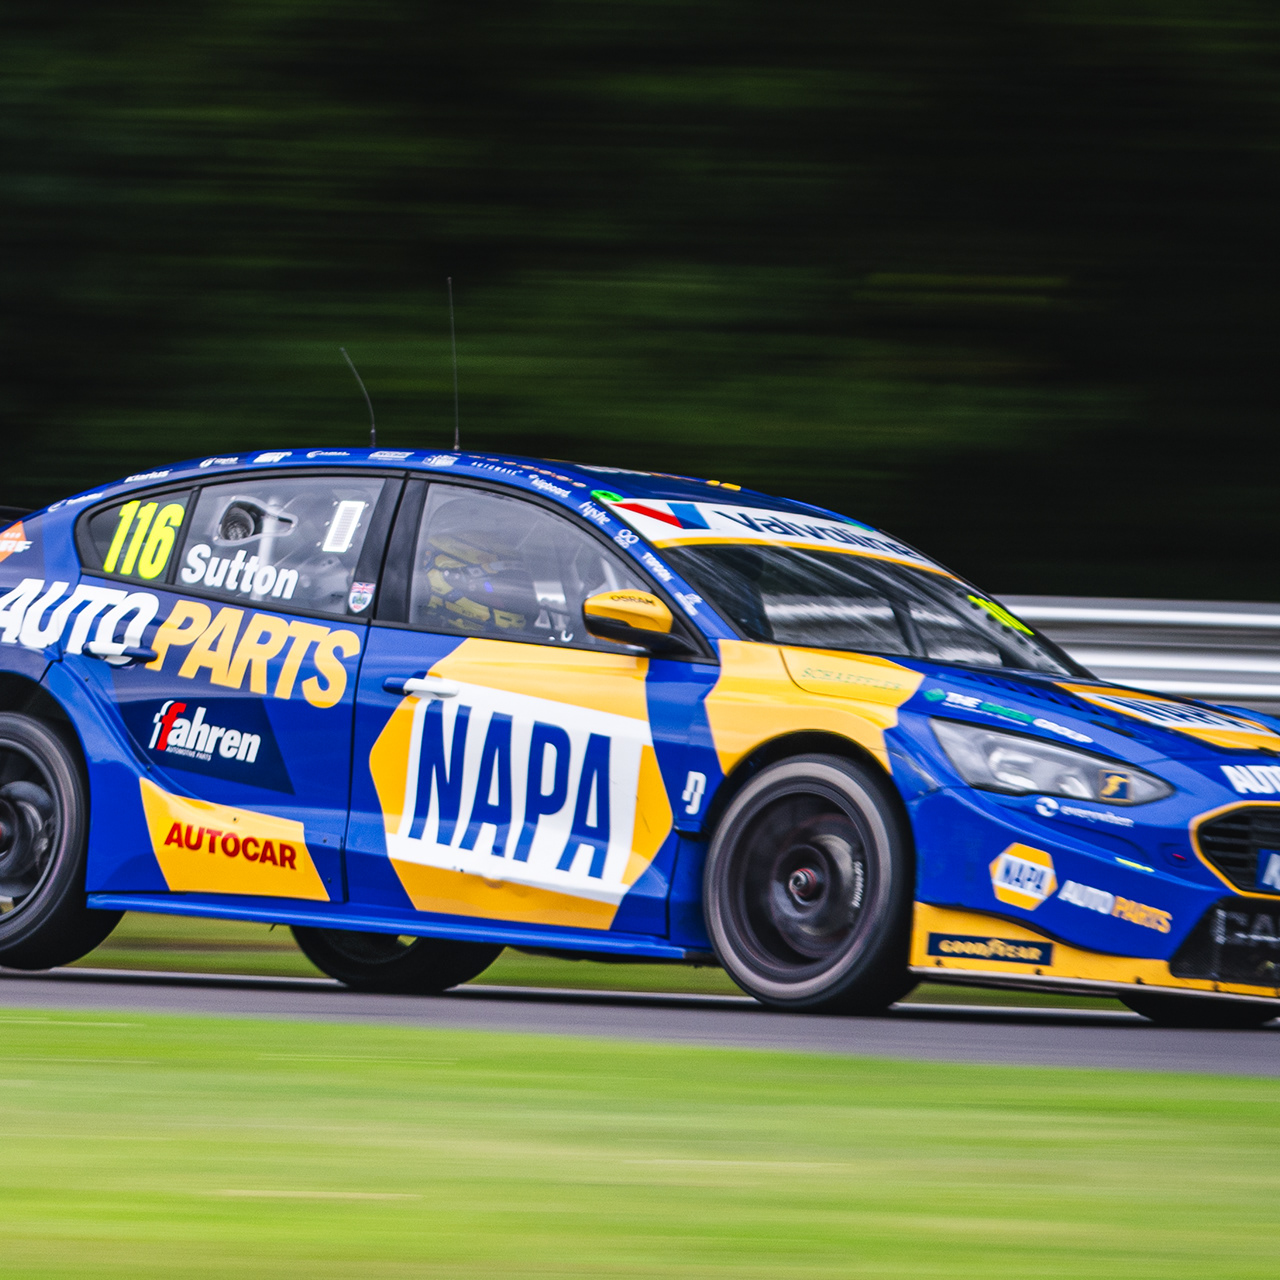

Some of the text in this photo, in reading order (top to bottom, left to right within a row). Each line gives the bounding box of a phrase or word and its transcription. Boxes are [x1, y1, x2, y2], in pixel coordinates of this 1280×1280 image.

[103, 501, 185, 579] 116
[712, 510, 927, 562] Valvoline
[180, 544, 299, 599] Sutton
[610, 594, 656, 607] OSRAM
[144, 600, 361, 709] PARTS
[148, 700, 261, 763] fahren
[408, 699, 611, 880] NAPA
[164, 822, 297, 870] AUTOCAR
[1001, 859, 1047, 892] NAPA
[1110, 895, 1173, 934] PARTS
[939, 938, 1043, 960] GOODYEAR
